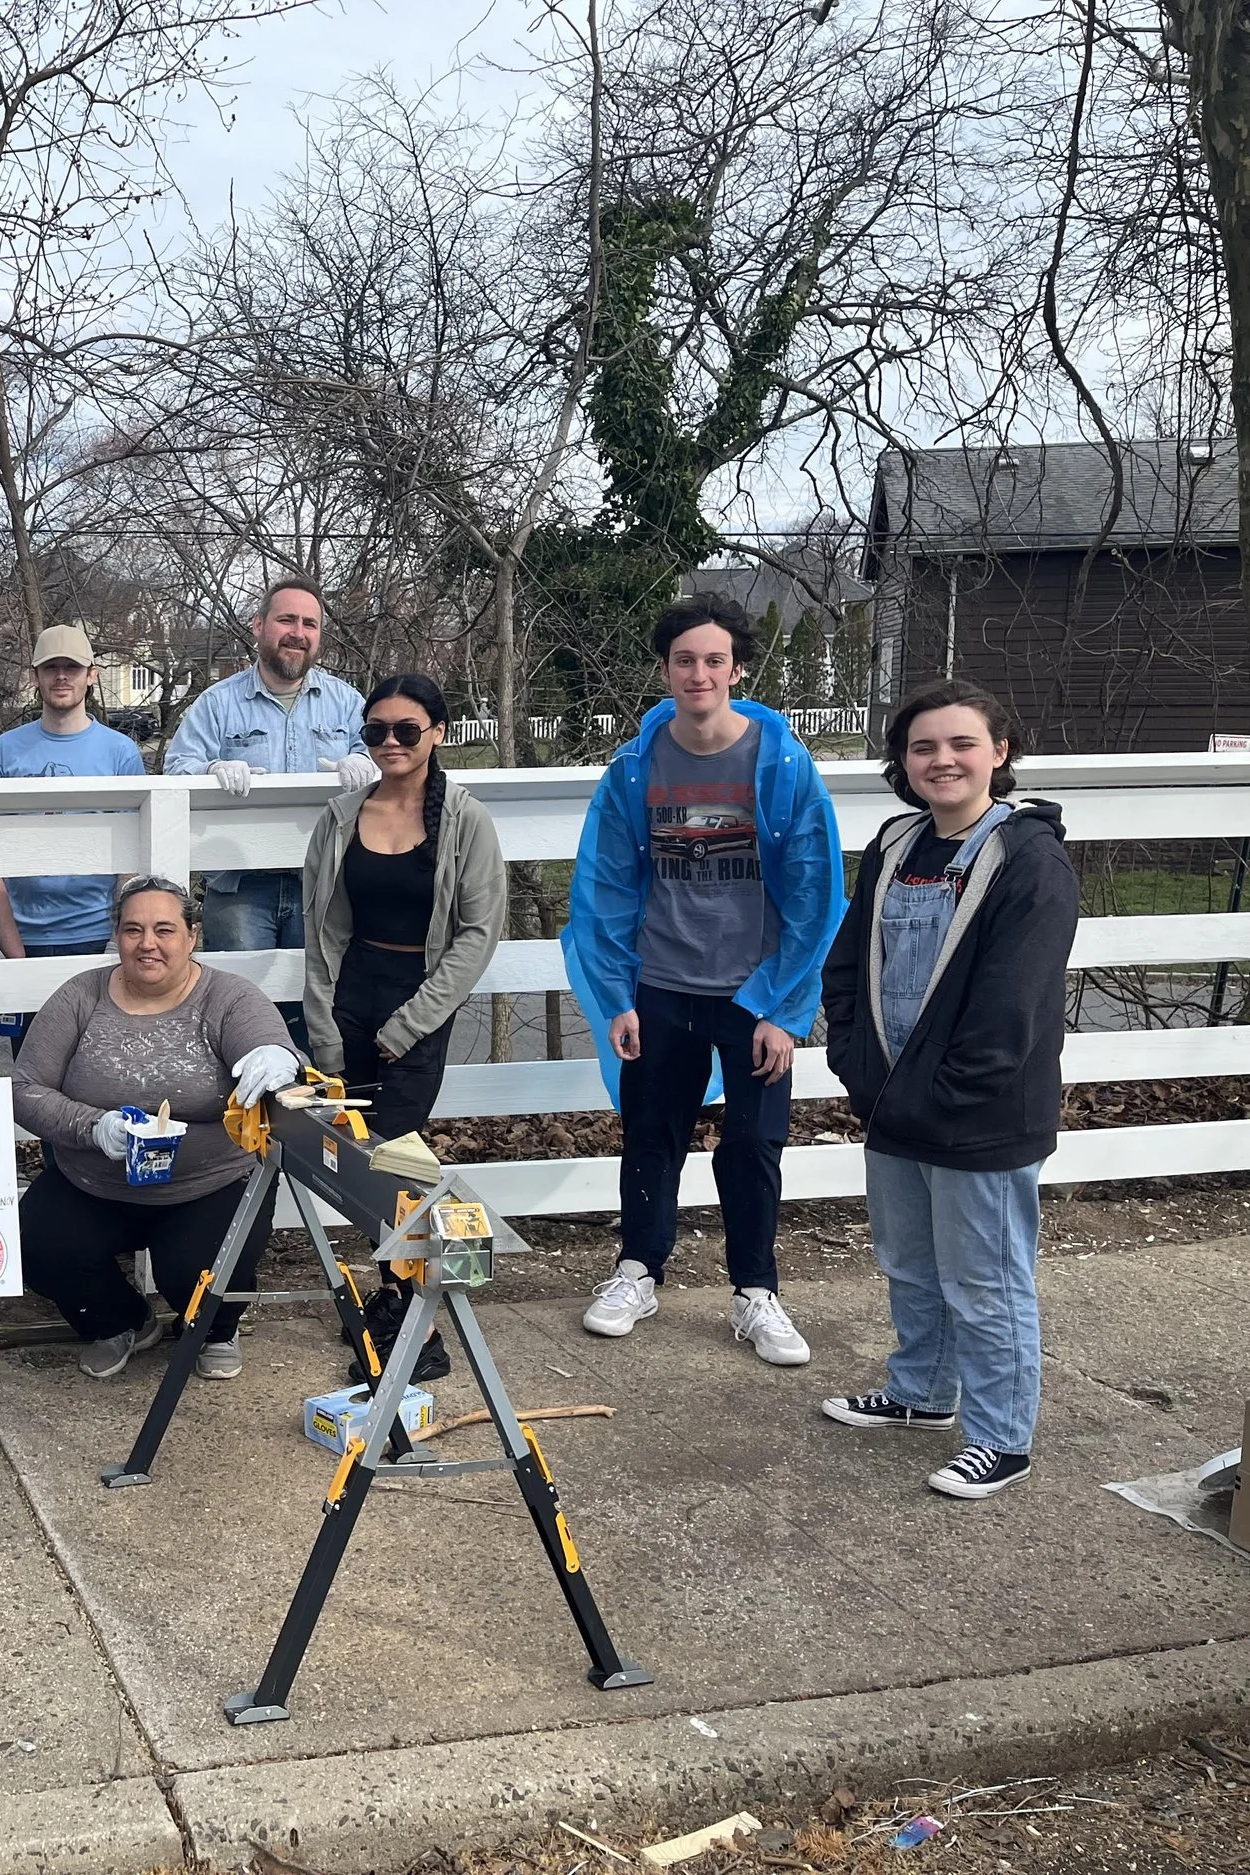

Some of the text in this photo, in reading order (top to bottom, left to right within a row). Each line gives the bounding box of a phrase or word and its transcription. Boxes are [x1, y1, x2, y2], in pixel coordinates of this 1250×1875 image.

[1222, 740, 1247, 748] PARKING
[656, 807, 688, 824] 500-KR
[697, 870, 713, 882] THE
[312, 1420, 337, 1438] GLOVES
